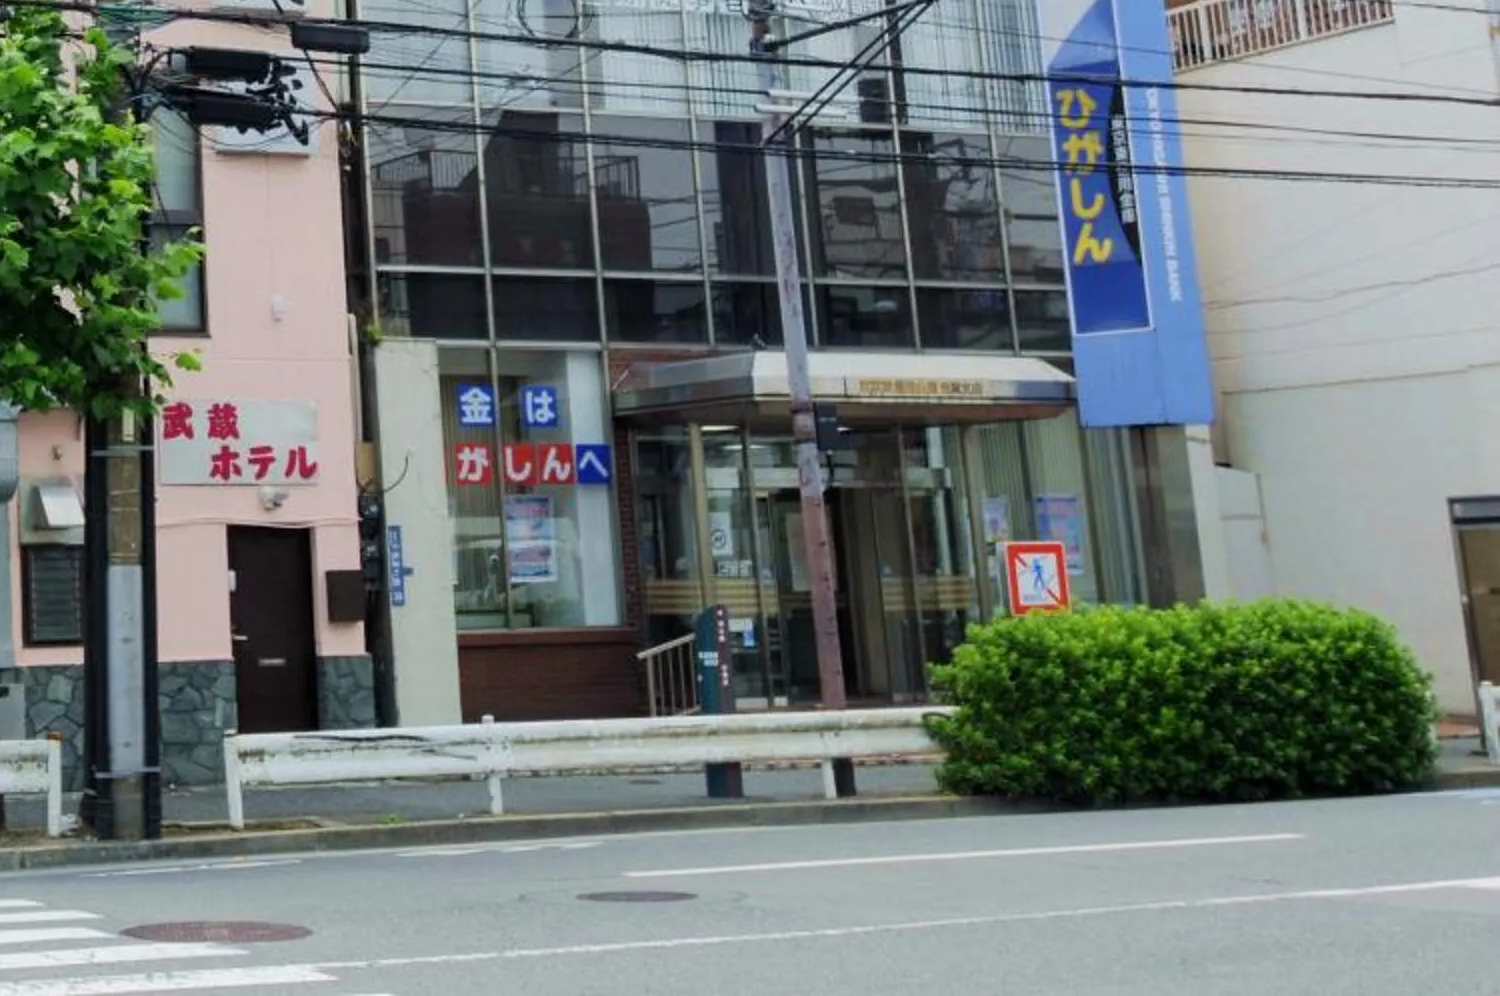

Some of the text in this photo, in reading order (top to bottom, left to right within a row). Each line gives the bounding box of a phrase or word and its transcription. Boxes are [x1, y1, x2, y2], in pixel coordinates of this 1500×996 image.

[1057, 88, 1113, 264] ひがしん
[162, 402, 240, 440] 武蔵
[209, 444, 317, 481] ホテル
[457, 446, 609, 482] がしんへ
